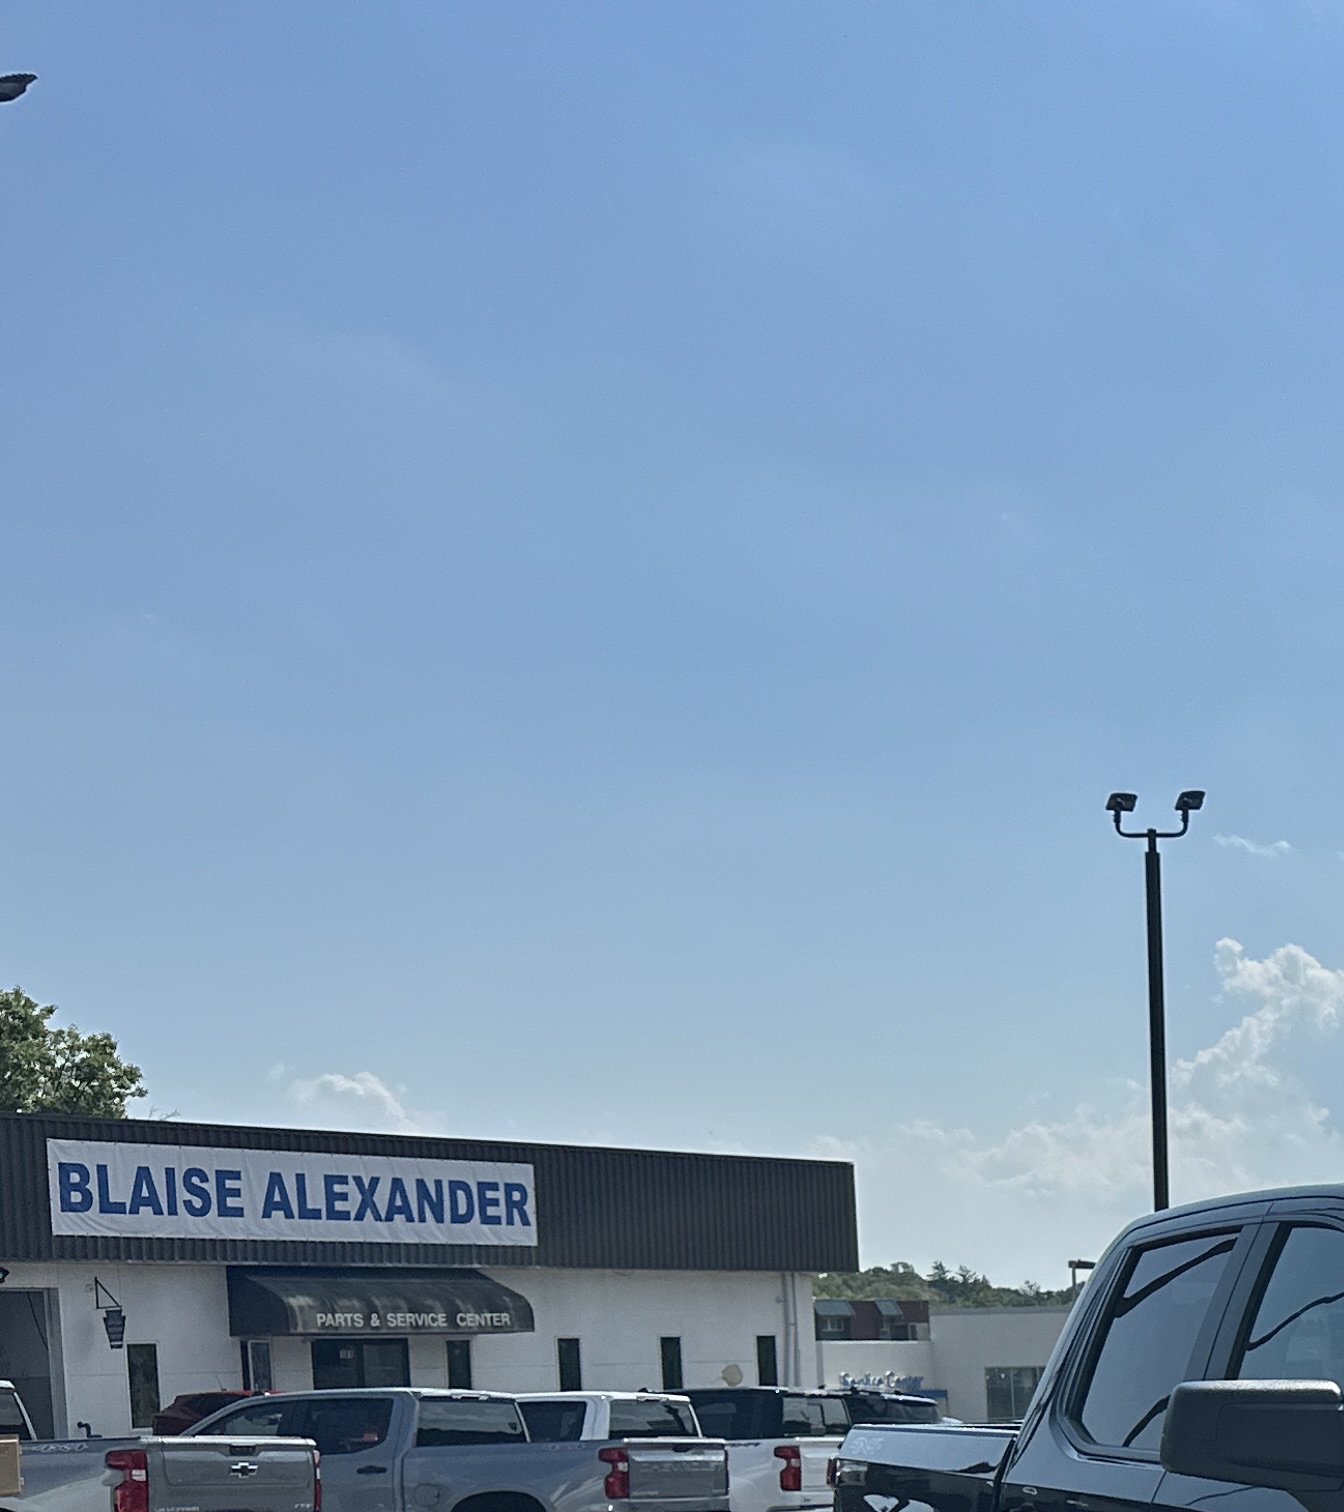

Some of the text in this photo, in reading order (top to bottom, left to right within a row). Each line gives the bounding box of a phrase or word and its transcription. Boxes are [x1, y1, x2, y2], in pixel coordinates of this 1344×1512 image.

[58, 1162, 532, 1227] BLAISE ALEXANDER
[316, 1313, 511, 1327] PARTS & SERVICE CENTER
